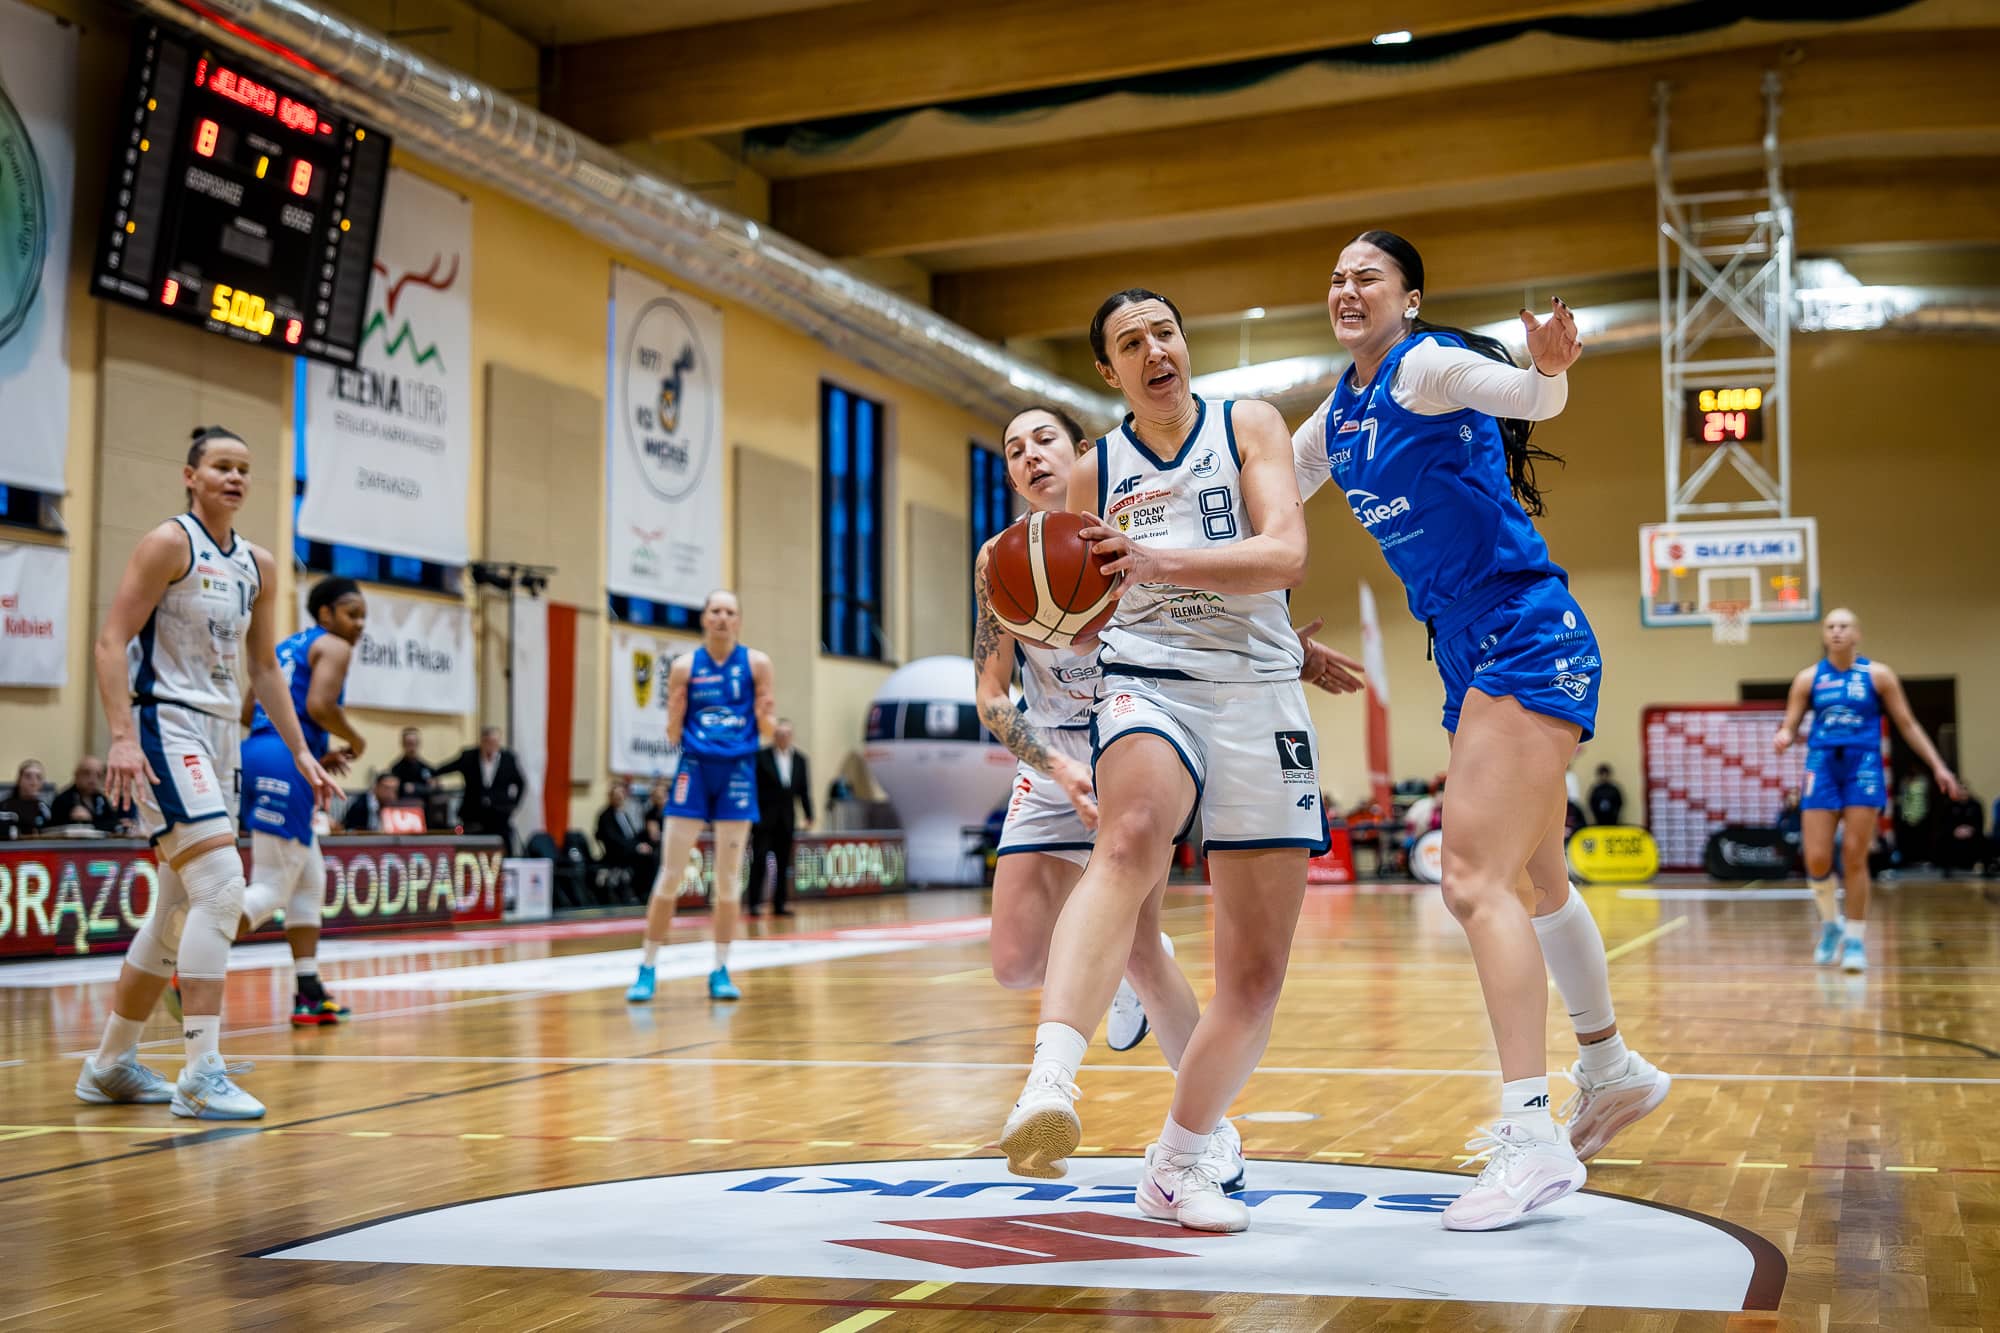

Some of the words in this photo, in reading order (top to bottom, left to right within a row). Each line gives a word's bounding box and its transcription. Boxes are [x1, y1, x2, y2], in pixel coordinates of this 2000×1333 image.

[196, 118, 220, 157] 8
[290, 159, 313, 196] 8
[1360, 416, 1378, 461] 7
[1703, 411, 1746, 442] 24
[1113, 474, 1143, 495] 4F
[1133, 505, 1166, 519] DOLNY
[1199, 486, 1237, 540] 8
[1696, 542, 1795, 557] SUZUKI
[1296, 794, 1315, 811] 4F
